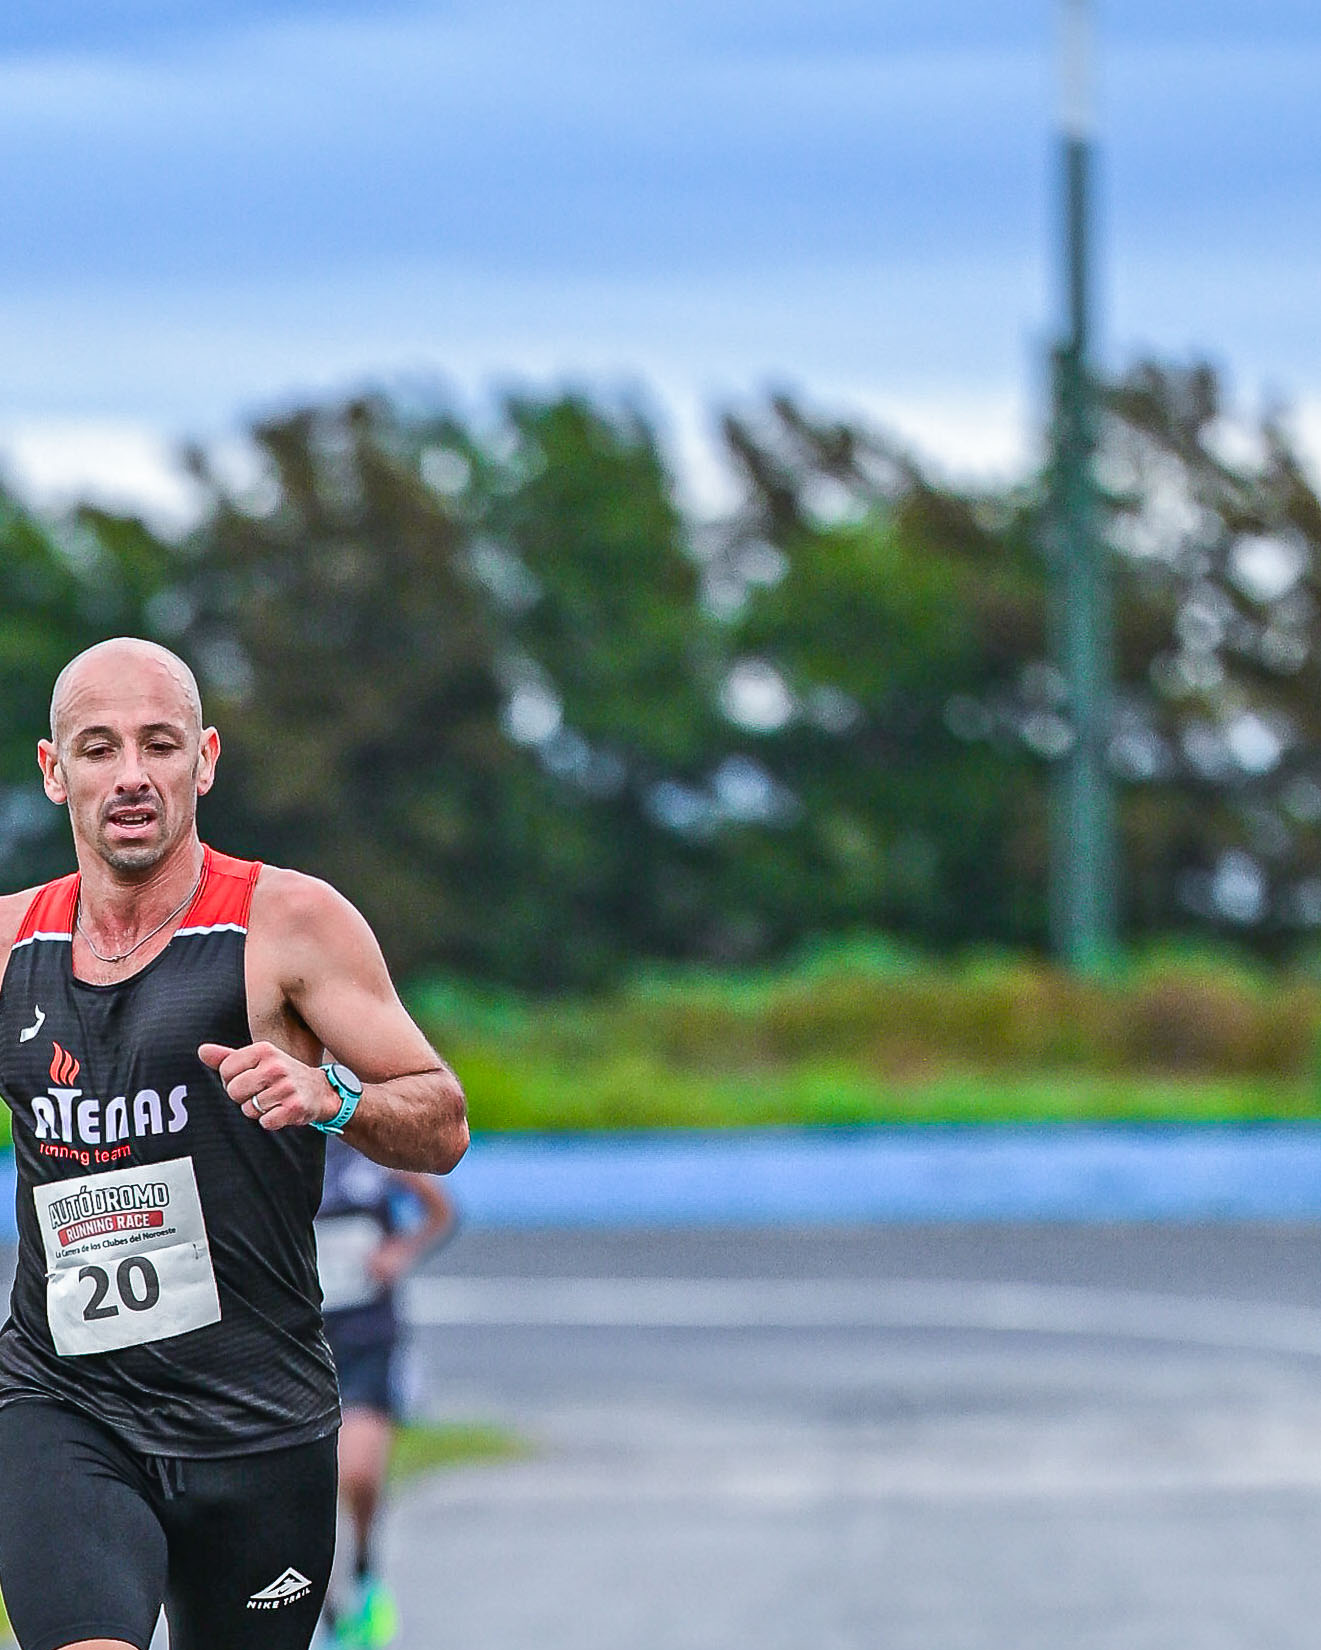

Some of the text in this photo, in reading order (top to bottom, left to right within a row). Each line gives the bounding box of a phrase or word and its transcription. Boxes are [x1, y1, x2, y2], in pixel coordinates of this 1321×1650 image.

[39, 1143, 132, 1167] runnng team
[65, 1213, 151, 1242] RUNNING RACE
[81, 1244, 89, 1252] de
[90, 1242, 101, 1250] los
[102, 1235, 129, 1248] Clubes
[129, 1232, 142, 1243] del
[143, 1226, 177, 1240] Noroeste
[78, 1256, 160, 1321] 20
[246, 1588, 311, 1609] NIKE TRAIL
